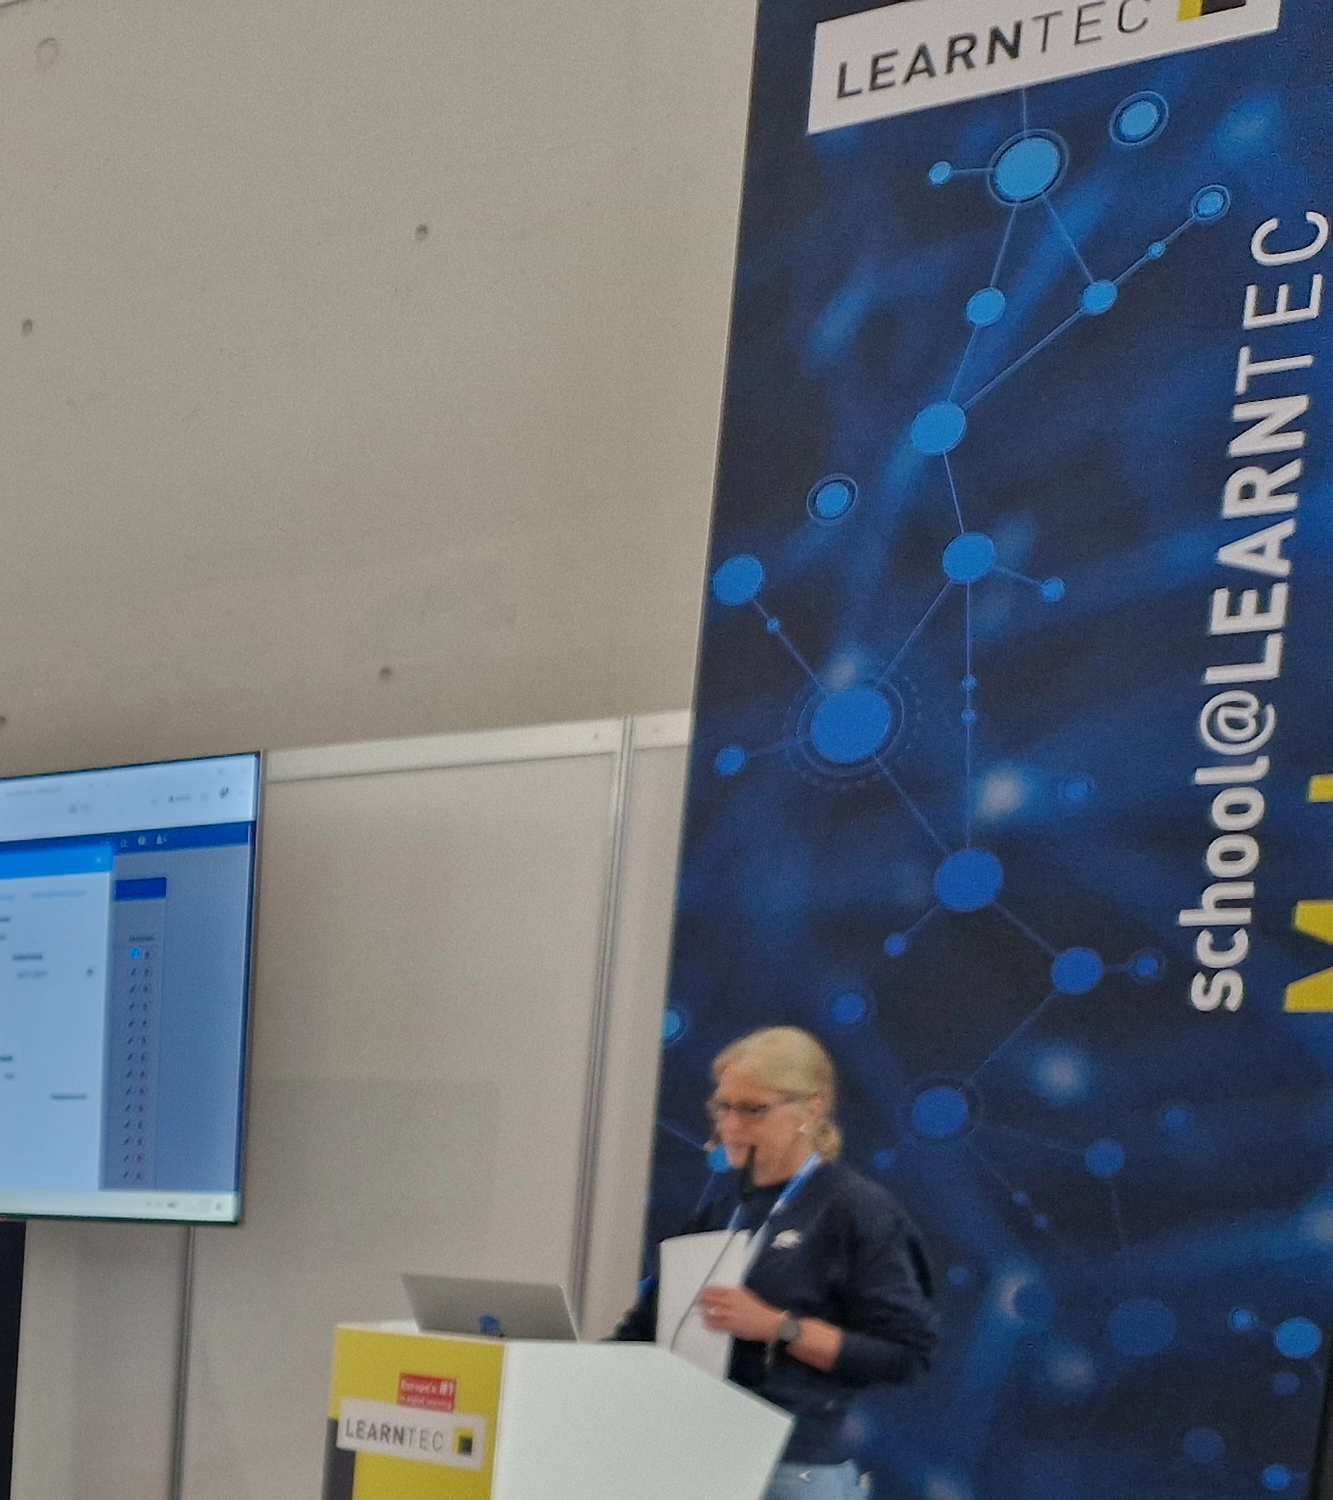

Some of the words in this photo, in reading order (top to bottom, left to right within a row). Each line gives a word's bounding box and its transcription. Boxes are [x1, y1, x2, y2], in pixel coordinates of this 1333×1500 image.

[836, 0, 1150, 99] LEARNTEC
[1178, 210, 1330, 1013] school@LEARNTEC
[345, 1417, 444, 1453] LEARNTEC
